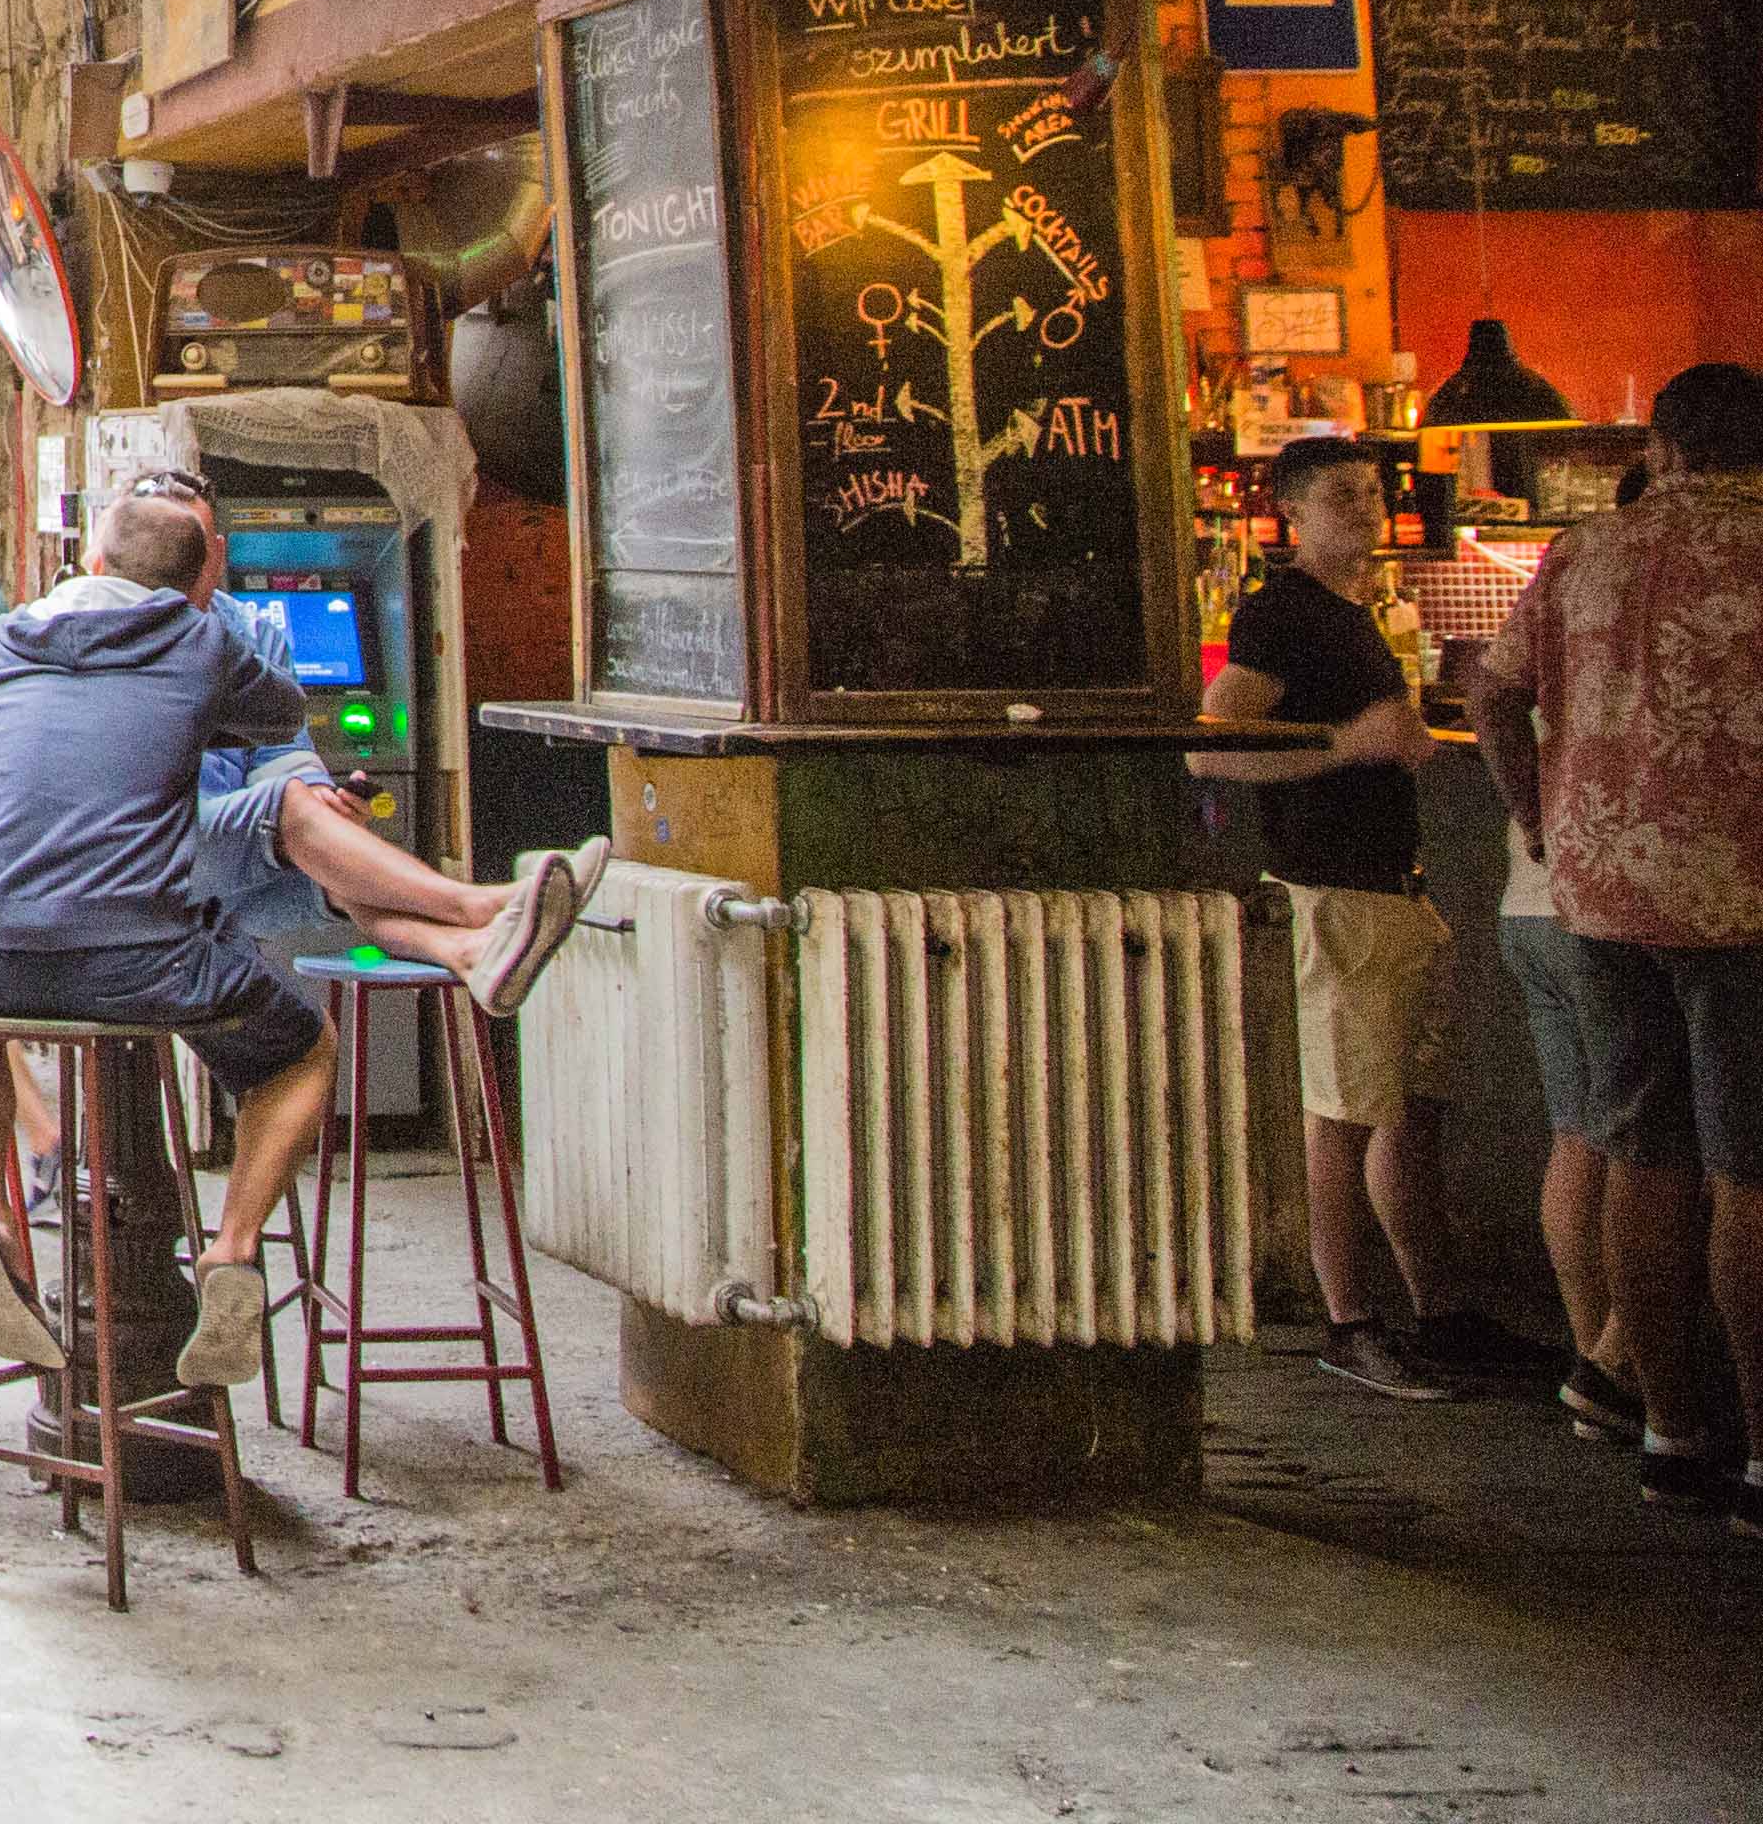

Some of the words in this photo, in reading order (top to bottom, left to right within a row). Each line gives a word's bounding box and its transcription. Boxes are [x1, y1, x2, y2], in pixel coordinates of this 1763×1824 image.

[874, 97, 981, 143] GRILL
[1023, 111, 1074, 146] AREA
[593, 184, 718, 241] TONIGHT
[792, 205, 851, 250] BAR
[1011, 183, 1111, 304] COCKTAILS
[1046, 396, 1120, 462] ATM
[823, 470, 930, 524] SHISHA
